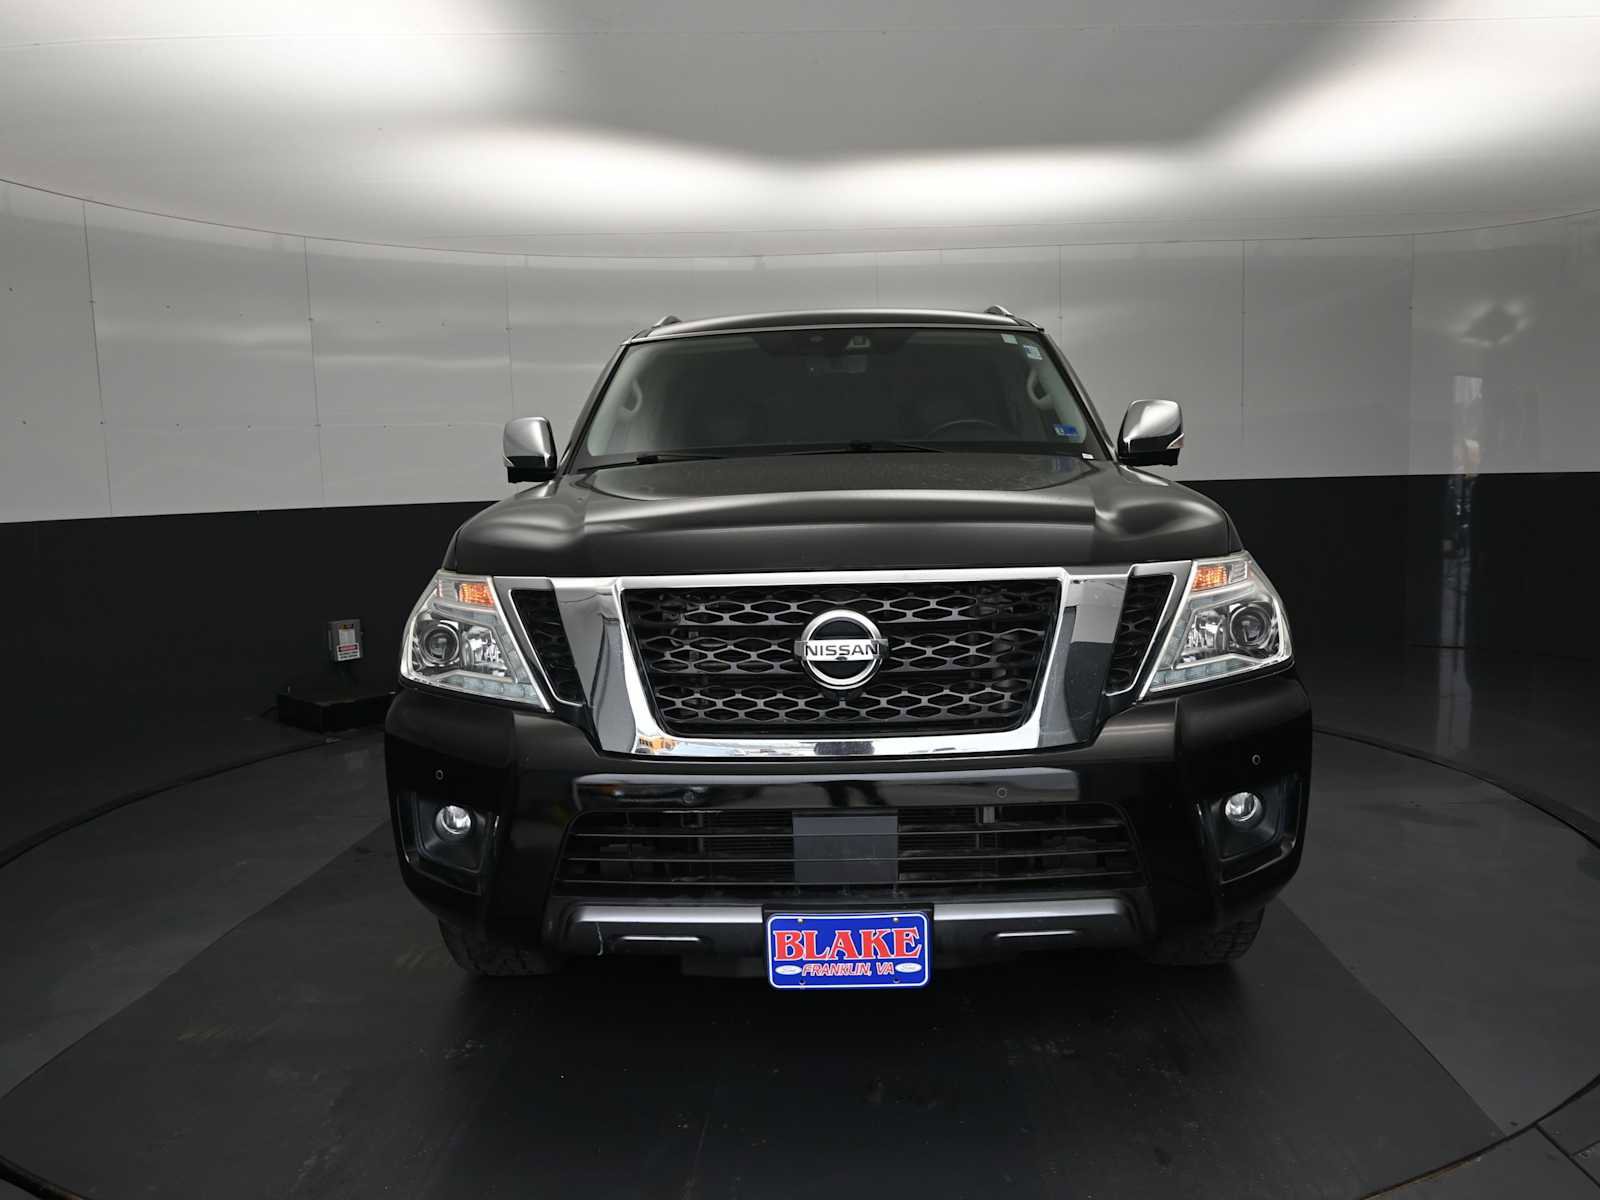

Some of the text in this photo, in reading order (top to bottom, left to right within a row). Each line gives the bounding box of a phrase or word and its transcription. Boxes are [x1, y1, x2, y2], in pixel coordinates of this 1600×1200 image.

[805, 644, 878, 657] NISSAN
[773, 927, 922, 961] BLAKE
[801, 962, 872, 976] FRANKLIN,
[876, 961, 895, 975] VA
